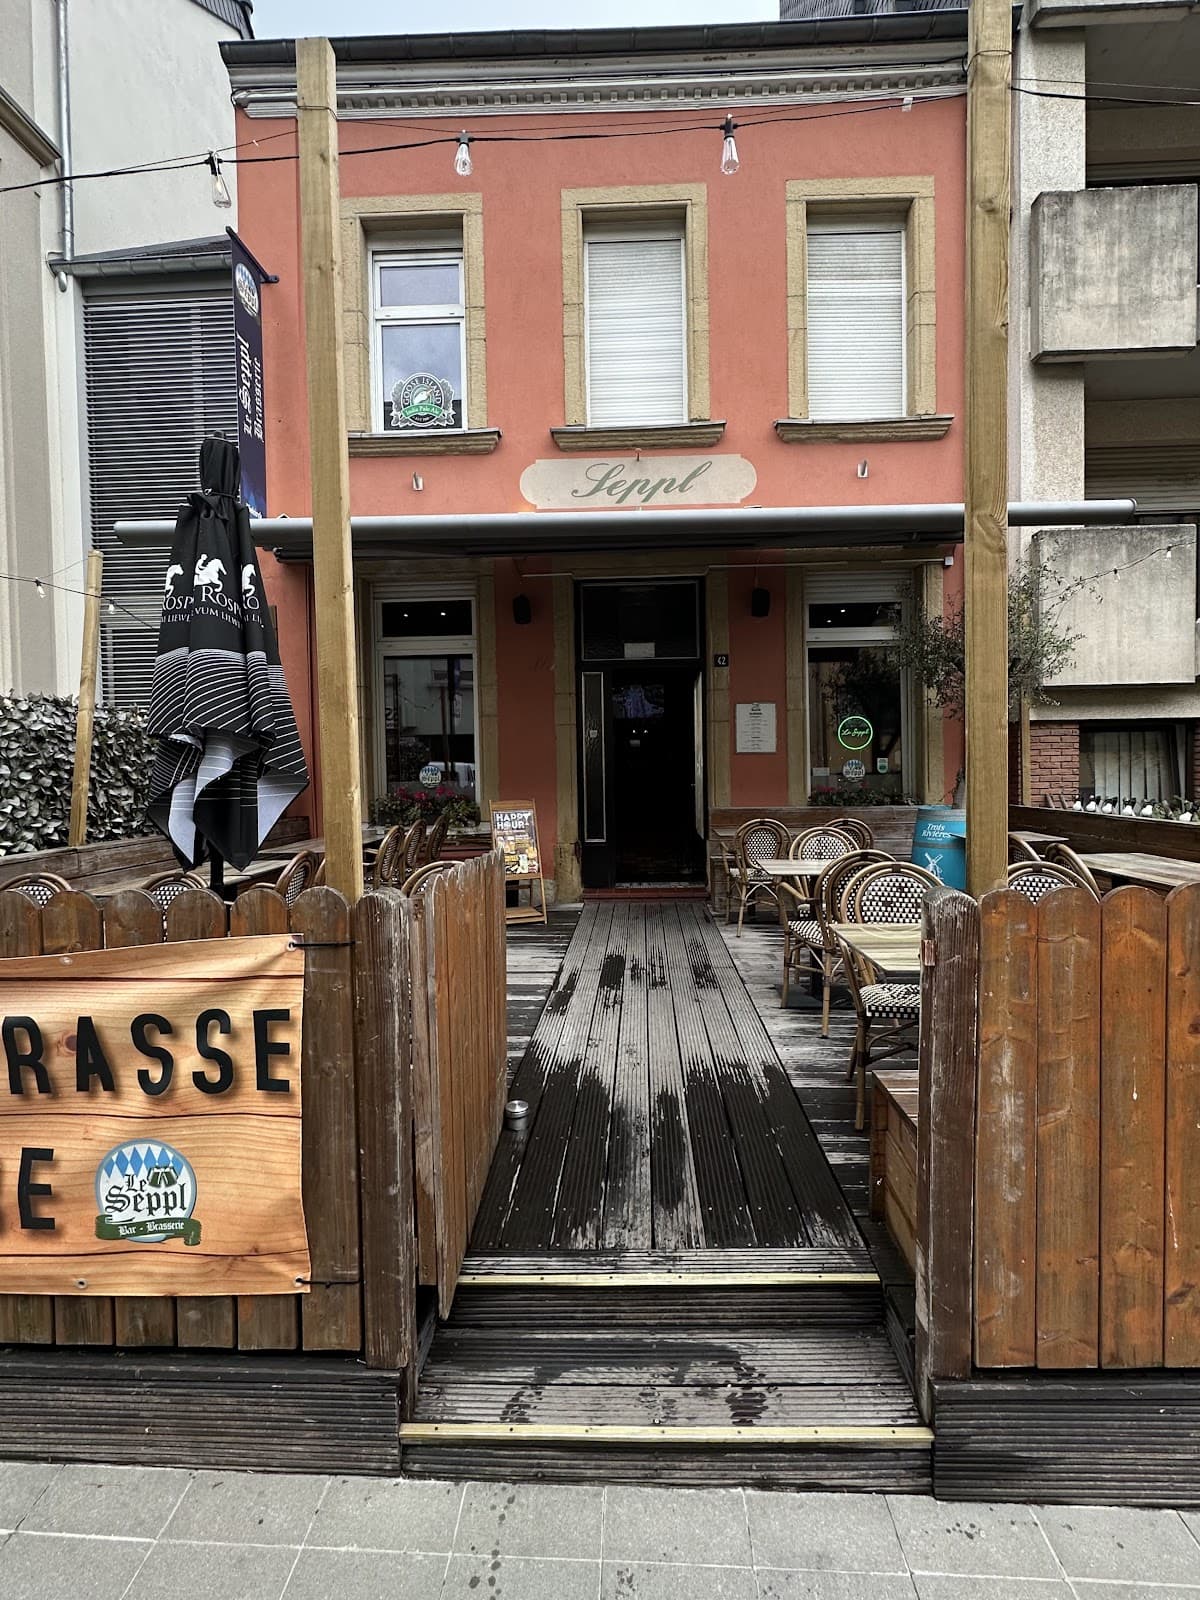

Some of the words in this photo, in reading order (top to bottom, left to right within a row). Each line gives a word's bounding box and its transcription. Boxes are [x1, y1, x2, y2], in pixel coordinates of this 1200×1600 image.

[236, 331, 252, 414] Seppl
[252, 357, 265, 443] Brasserie
[402, 378, 420, 405] GOOSE
[422, 377, 442, 404] ISLAND
[571, 460, 713, 504] Seppl
[717, 656, 726, 665] 42
[496, 812, 531, 823] HAPPY
[497, 820, 525, 830] HOUR
[927, 823, 946, 831] Trois
[2, 1008, 290, 1096] RASSE
[125, 1173, 147, 1193] Le
[105, 1183, 187, 1216] Seppl
[118, 1225, 137, 1236] Bar
[147, 1221, 185, 1232] Brasserie
